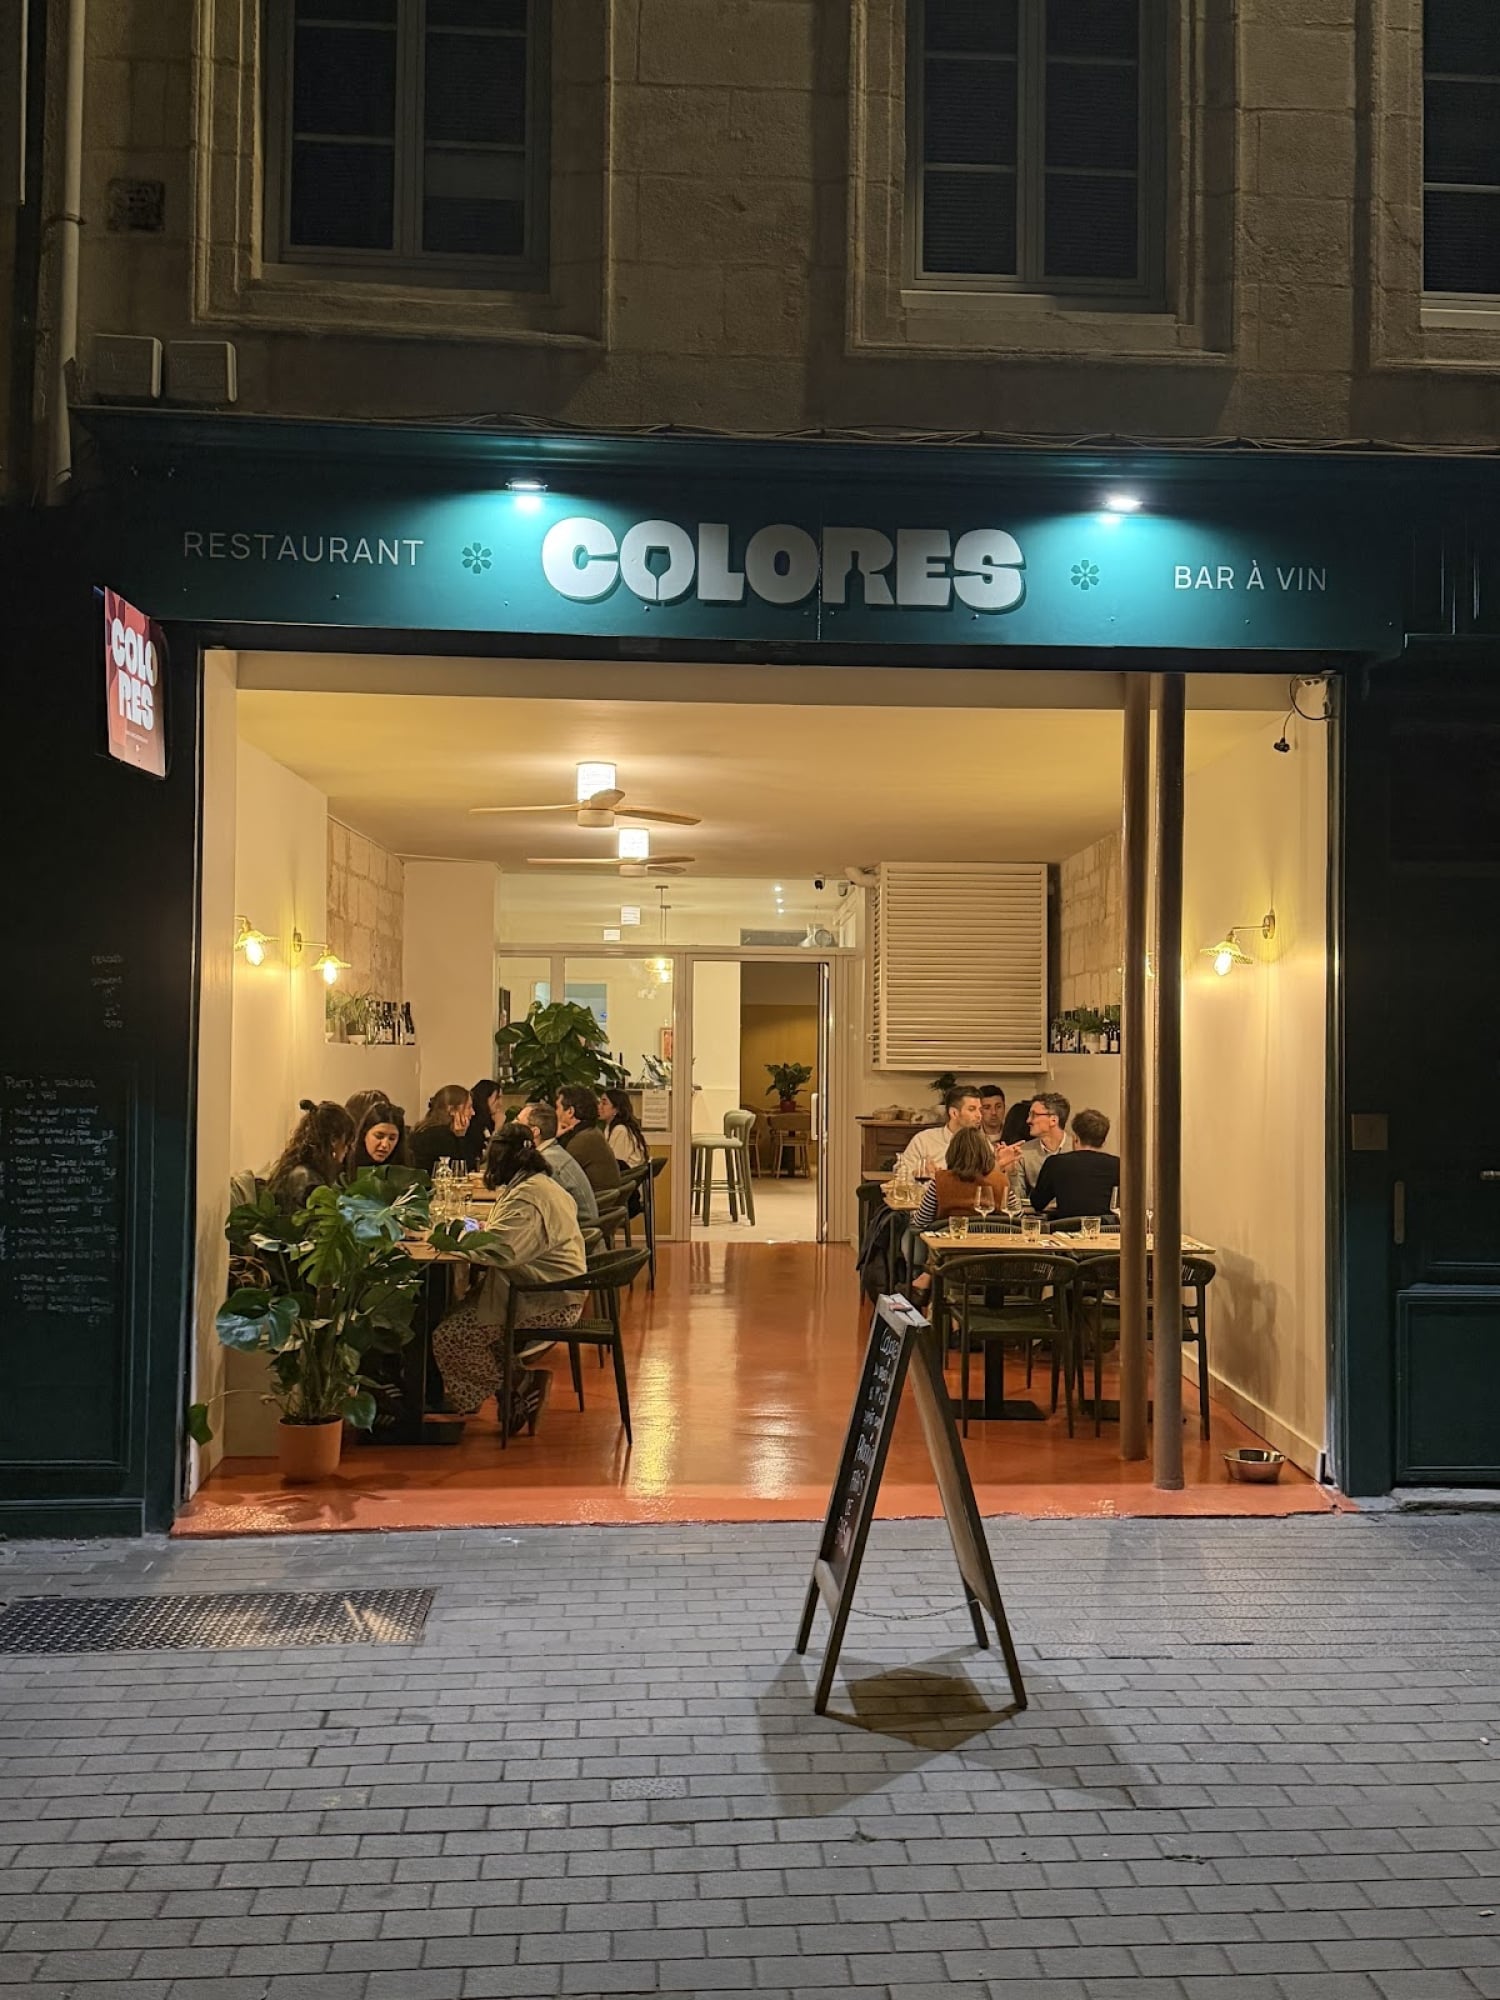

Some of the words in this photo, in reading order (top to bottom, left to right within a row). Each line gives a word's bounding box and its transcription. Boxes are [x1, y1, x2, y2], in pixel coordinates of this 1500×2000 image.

[183, 530, 425, 567] RESTAURANT
[541, 516, 1026, 612] COLORES
[1174, 565, 1235, 590] BAR
[1246, 559, 1265, 590] À
[1276, 567, 1326, 591] VIN
[111, 617, 159, 687] COLO
[117, 669, 154, 731] RES
